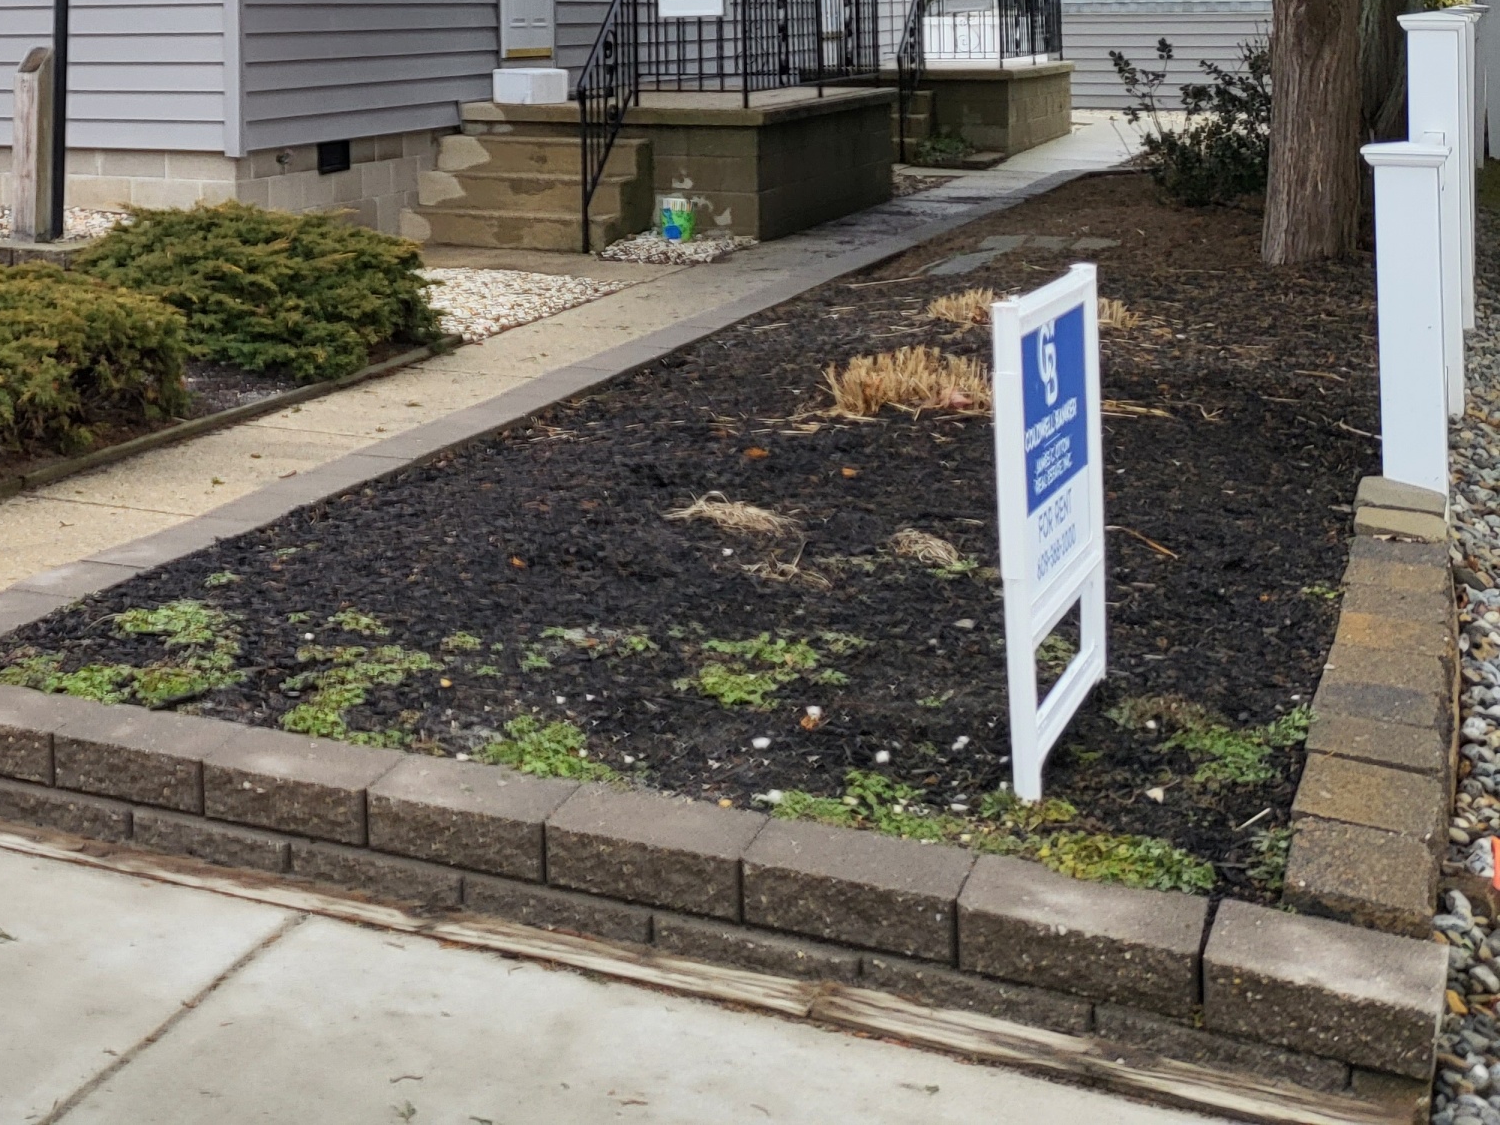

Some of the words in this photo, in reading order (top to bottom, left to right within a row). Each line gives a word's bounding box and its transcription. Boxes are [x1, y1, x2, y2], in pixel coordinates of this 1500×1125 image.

[1025, 410, 1056, 454] COLDWELL
[1055, 397, 1077, 430] BANKER
[1037, 505, 1054, 543] FOR
[1054, 486, 1072, 527] RENT
